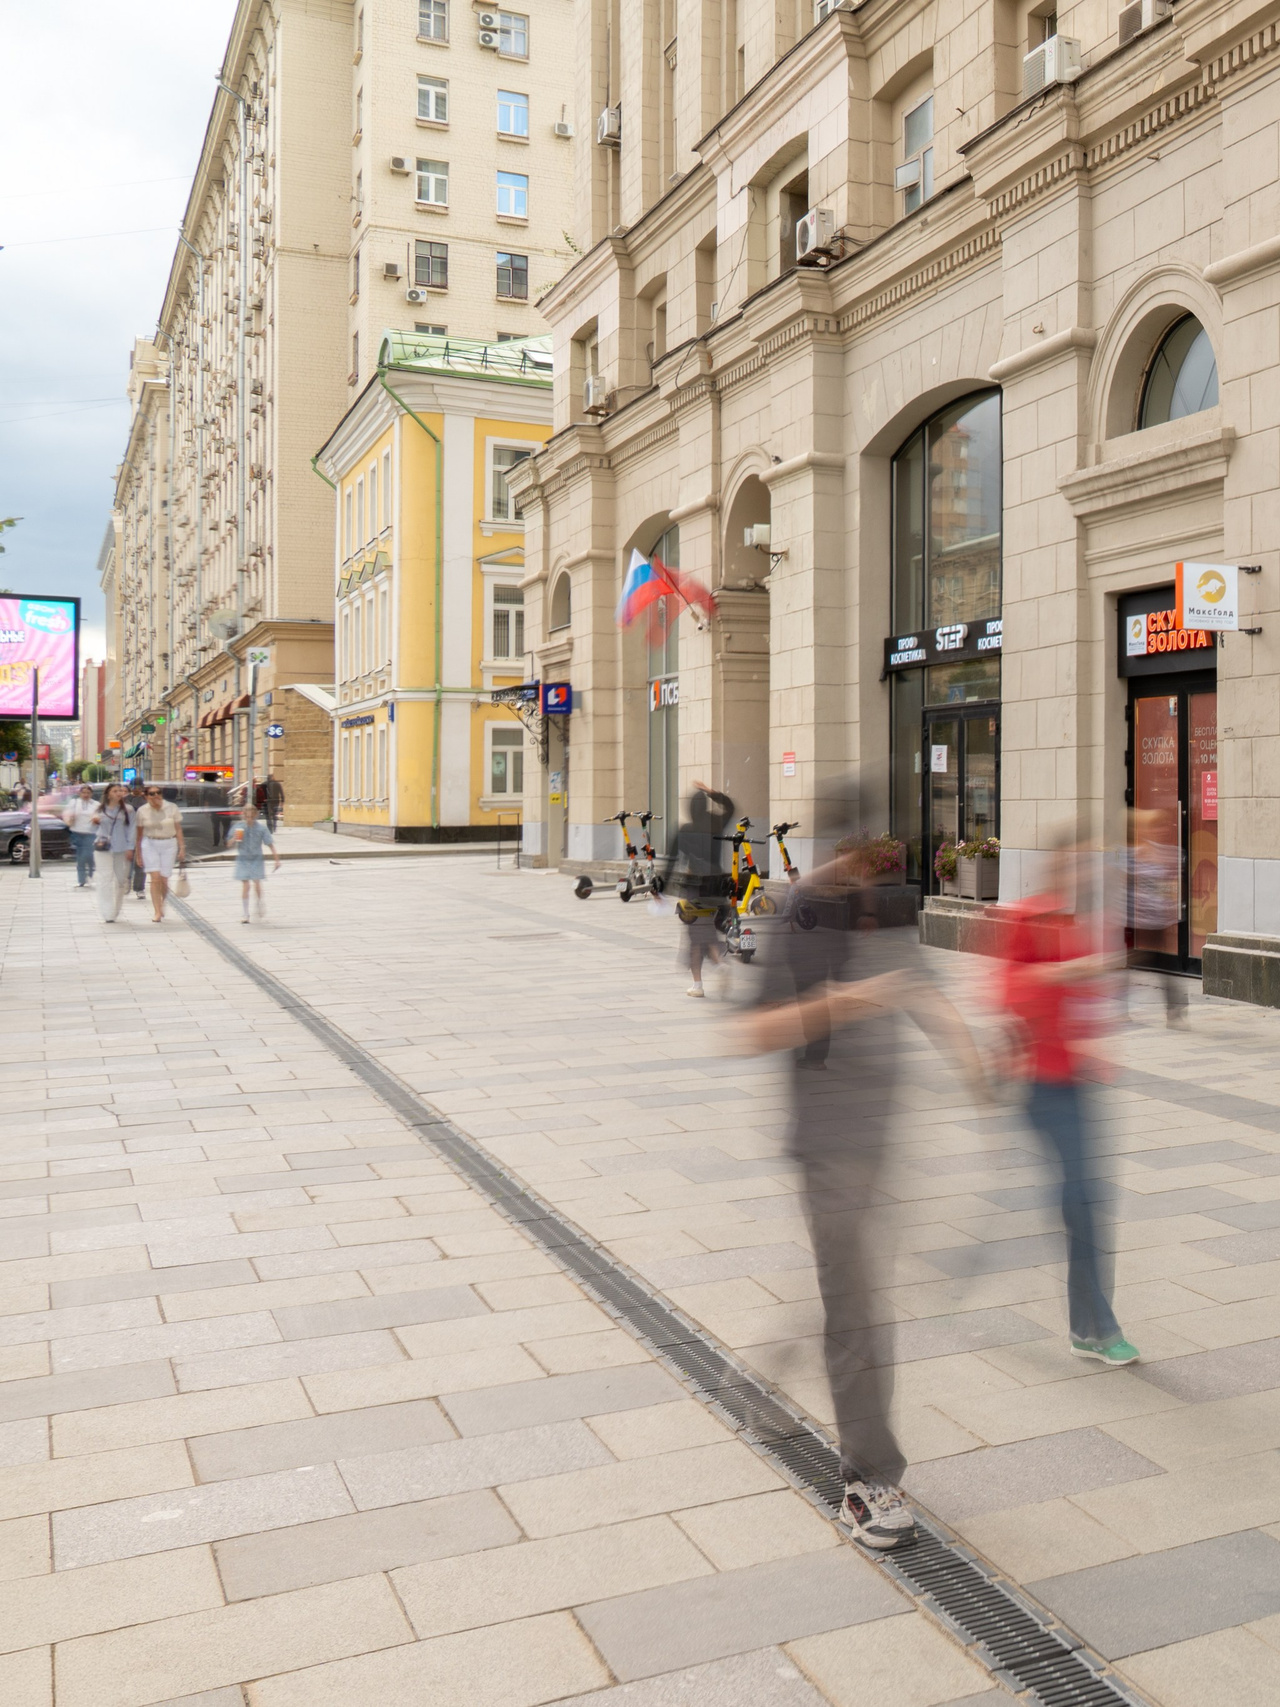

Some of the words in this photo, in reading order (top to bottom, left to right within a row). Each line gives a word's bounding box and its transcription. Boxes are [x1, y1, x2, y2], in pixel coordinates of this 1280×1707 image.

[1147, 608, 1176, 632] СКУ
[1188, 607, 1234, 617] МаксГолд
[935, 624, 968, 651] STEP
[977, 635, 1002, 651] КОСМЕТ
[1147, 630, 1208, 653] ЗОЛОТА
[890, 649, 925, 665] КОСМЕТИКА
[660, 682, 679, 705] ПСБ
[1142, 736, 1175, 749] СКУПКА
[1142, 752, 1175, 765] ЗОЛОТА
[1200, 754, 1208, 764] 10
